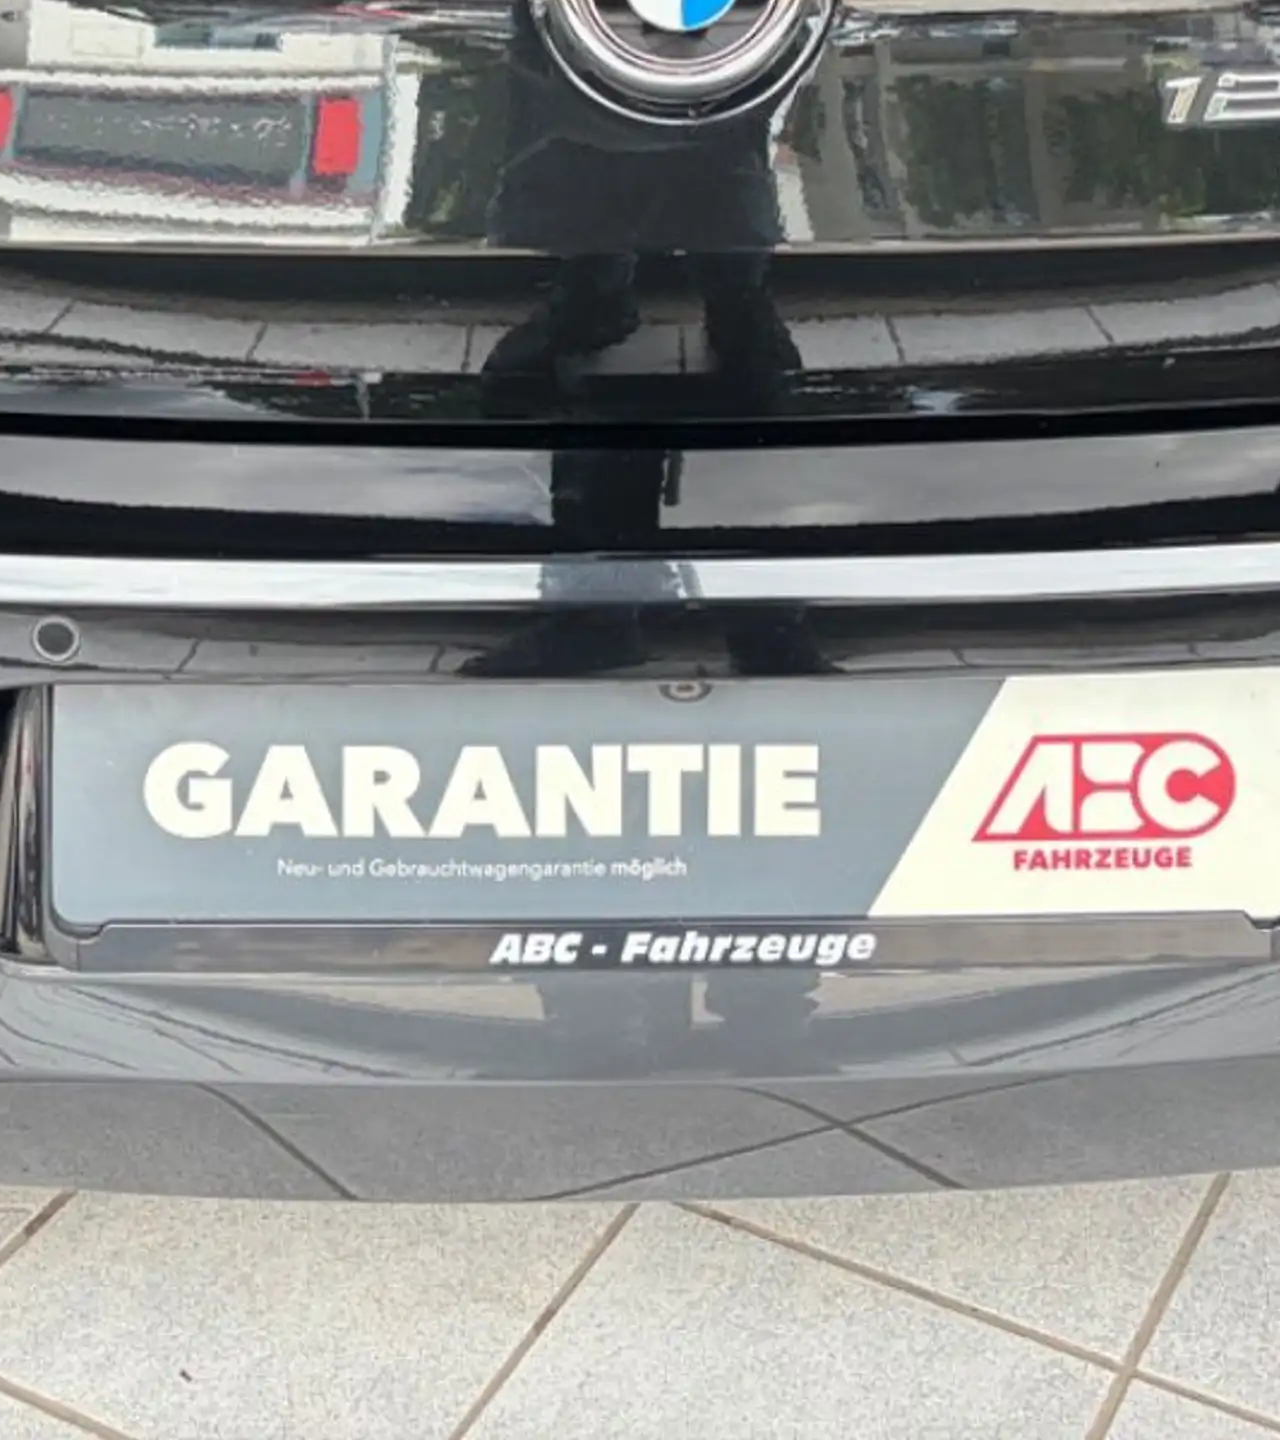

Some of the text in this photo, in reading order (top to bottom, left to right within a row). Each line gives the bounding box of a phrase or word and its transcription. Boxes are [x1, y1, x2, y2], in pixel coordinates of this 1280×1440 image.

[142, 741, 821, 838] GARANTIE
[277, 858, 687, 881] Neu- und Gebrauchtwagengarantie möglich
[1013, 846, 1193, 871] FAHRZEUGE
[489, 932, 582, 964] ABC
[621, 931, 876, 965] Fahrzeuge
